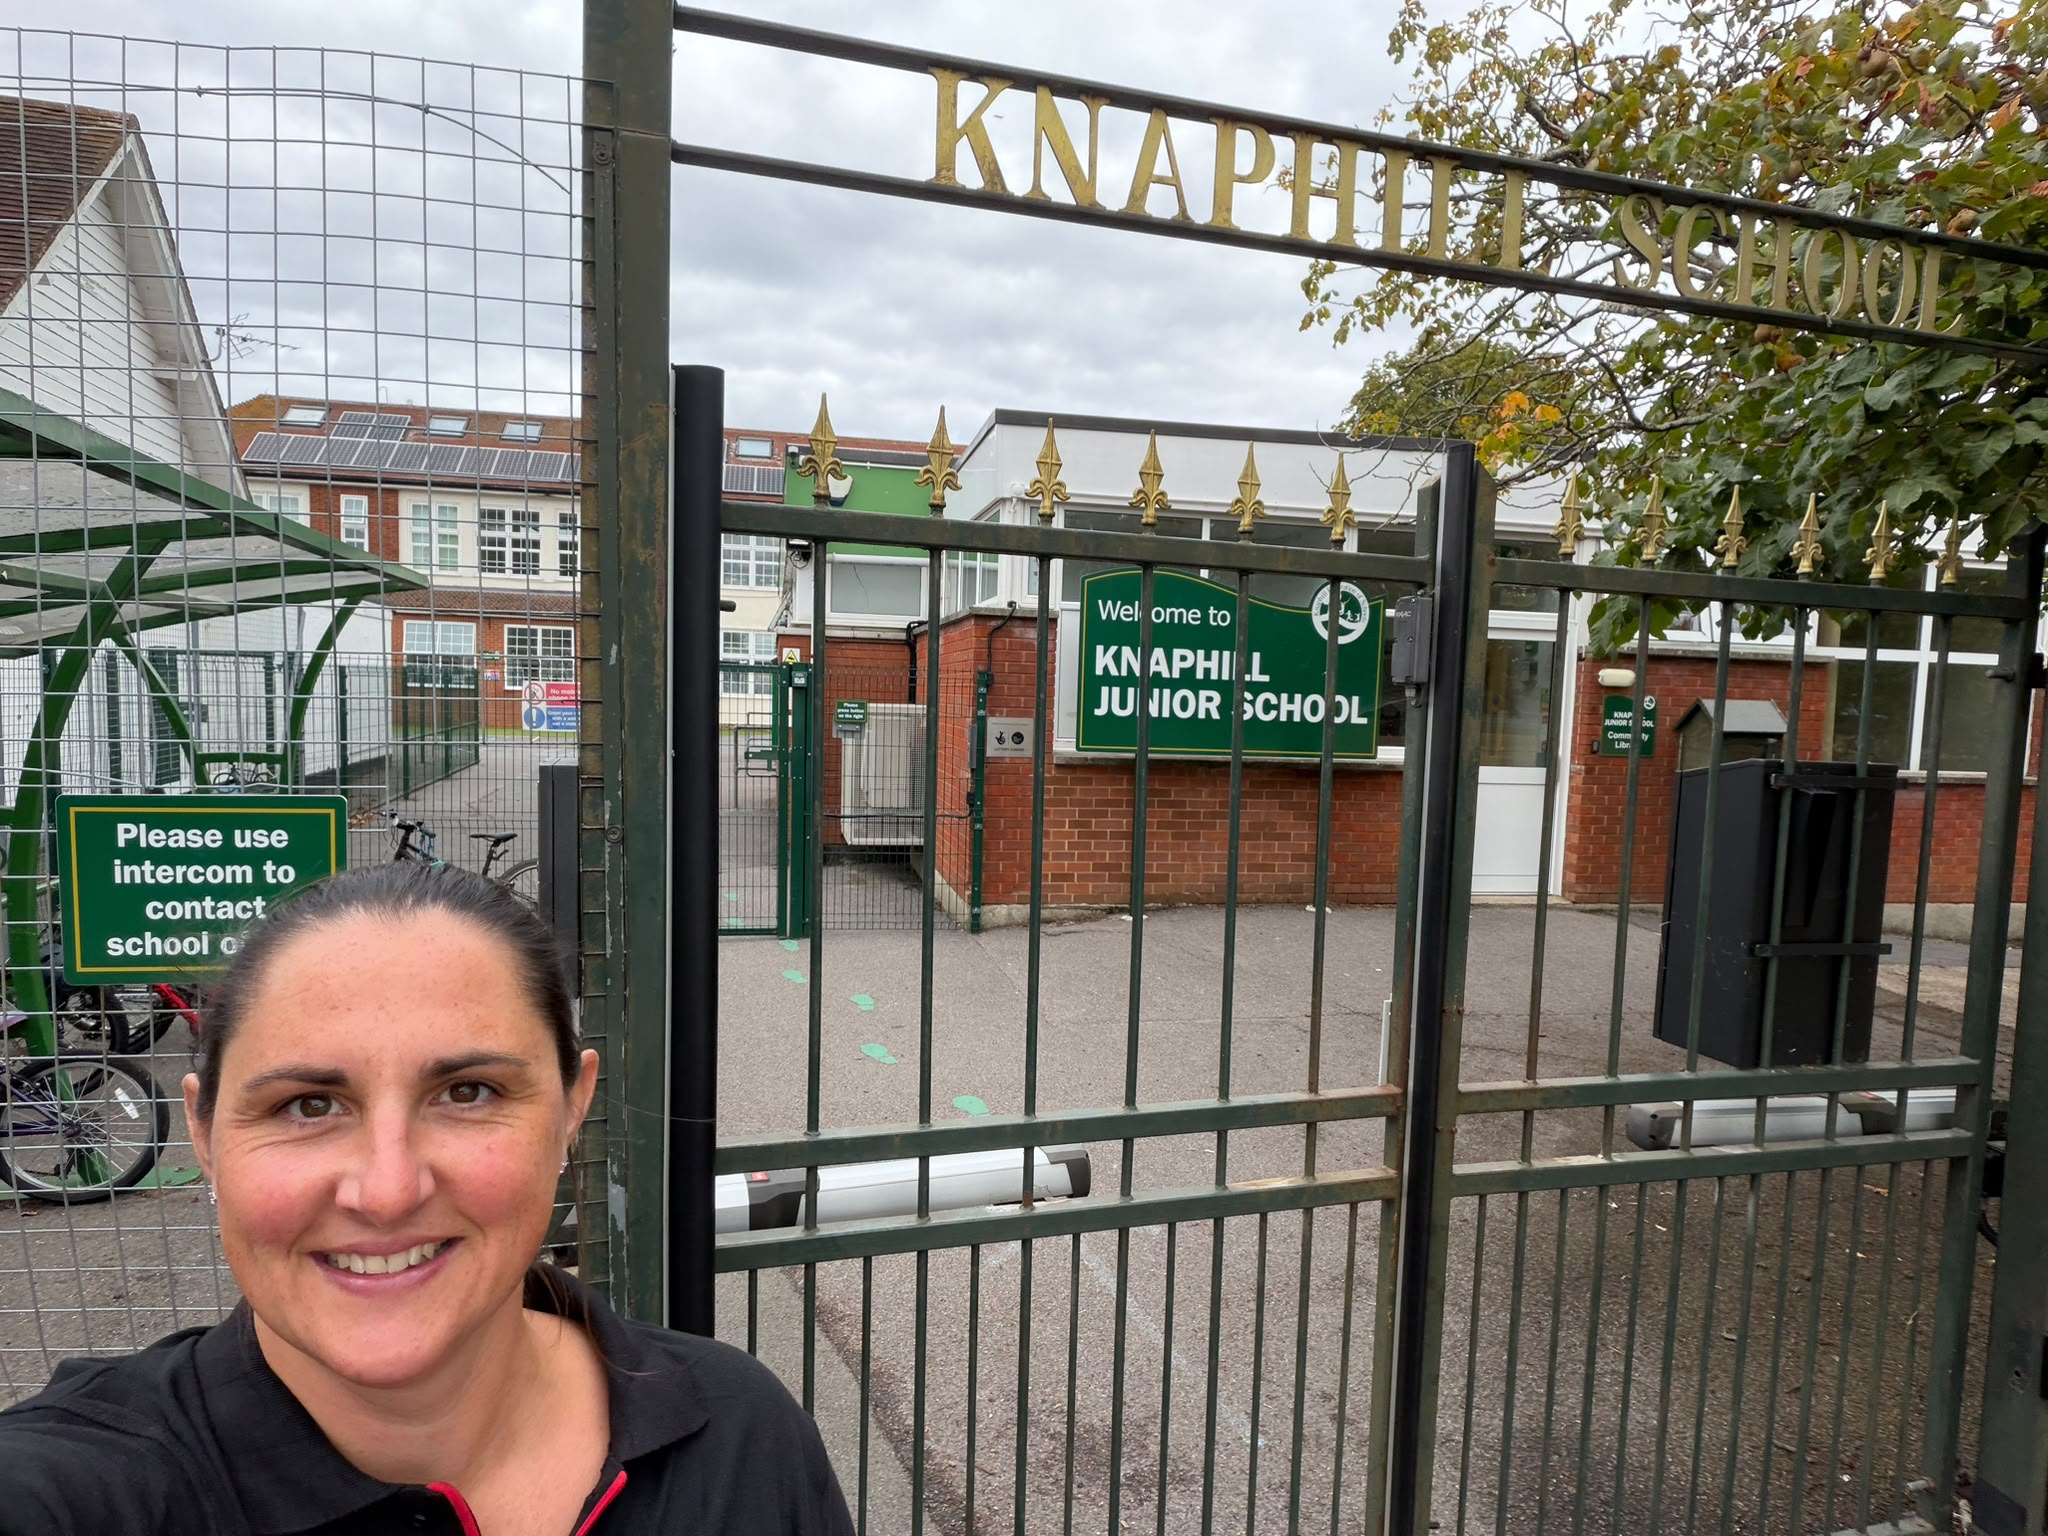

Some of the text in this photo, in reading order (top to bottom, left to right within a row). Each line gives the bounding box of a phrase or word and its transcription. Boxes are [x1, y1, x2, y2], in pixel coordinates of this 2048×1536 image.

[928, 66, 1963, 336] KNAPHILL SCHOOL
[1098, 599, 1231, 627] Welome to
[1094, 685, 1368, 724] JUNIOR SCHOOL
[1613, 711, 1646, 720] KNAP
[1604, 719, 1655, 728] JUNIOR SOOL
[1607, 731, 1650, 742] Commty
[1614, 741, 1632, 749] Libr
[116, 823, 289, 848] Please use
[113, 858, 296, 884] intercom to
[145, 896, 267, 920] contact
[106, 931, 209, 956] school
